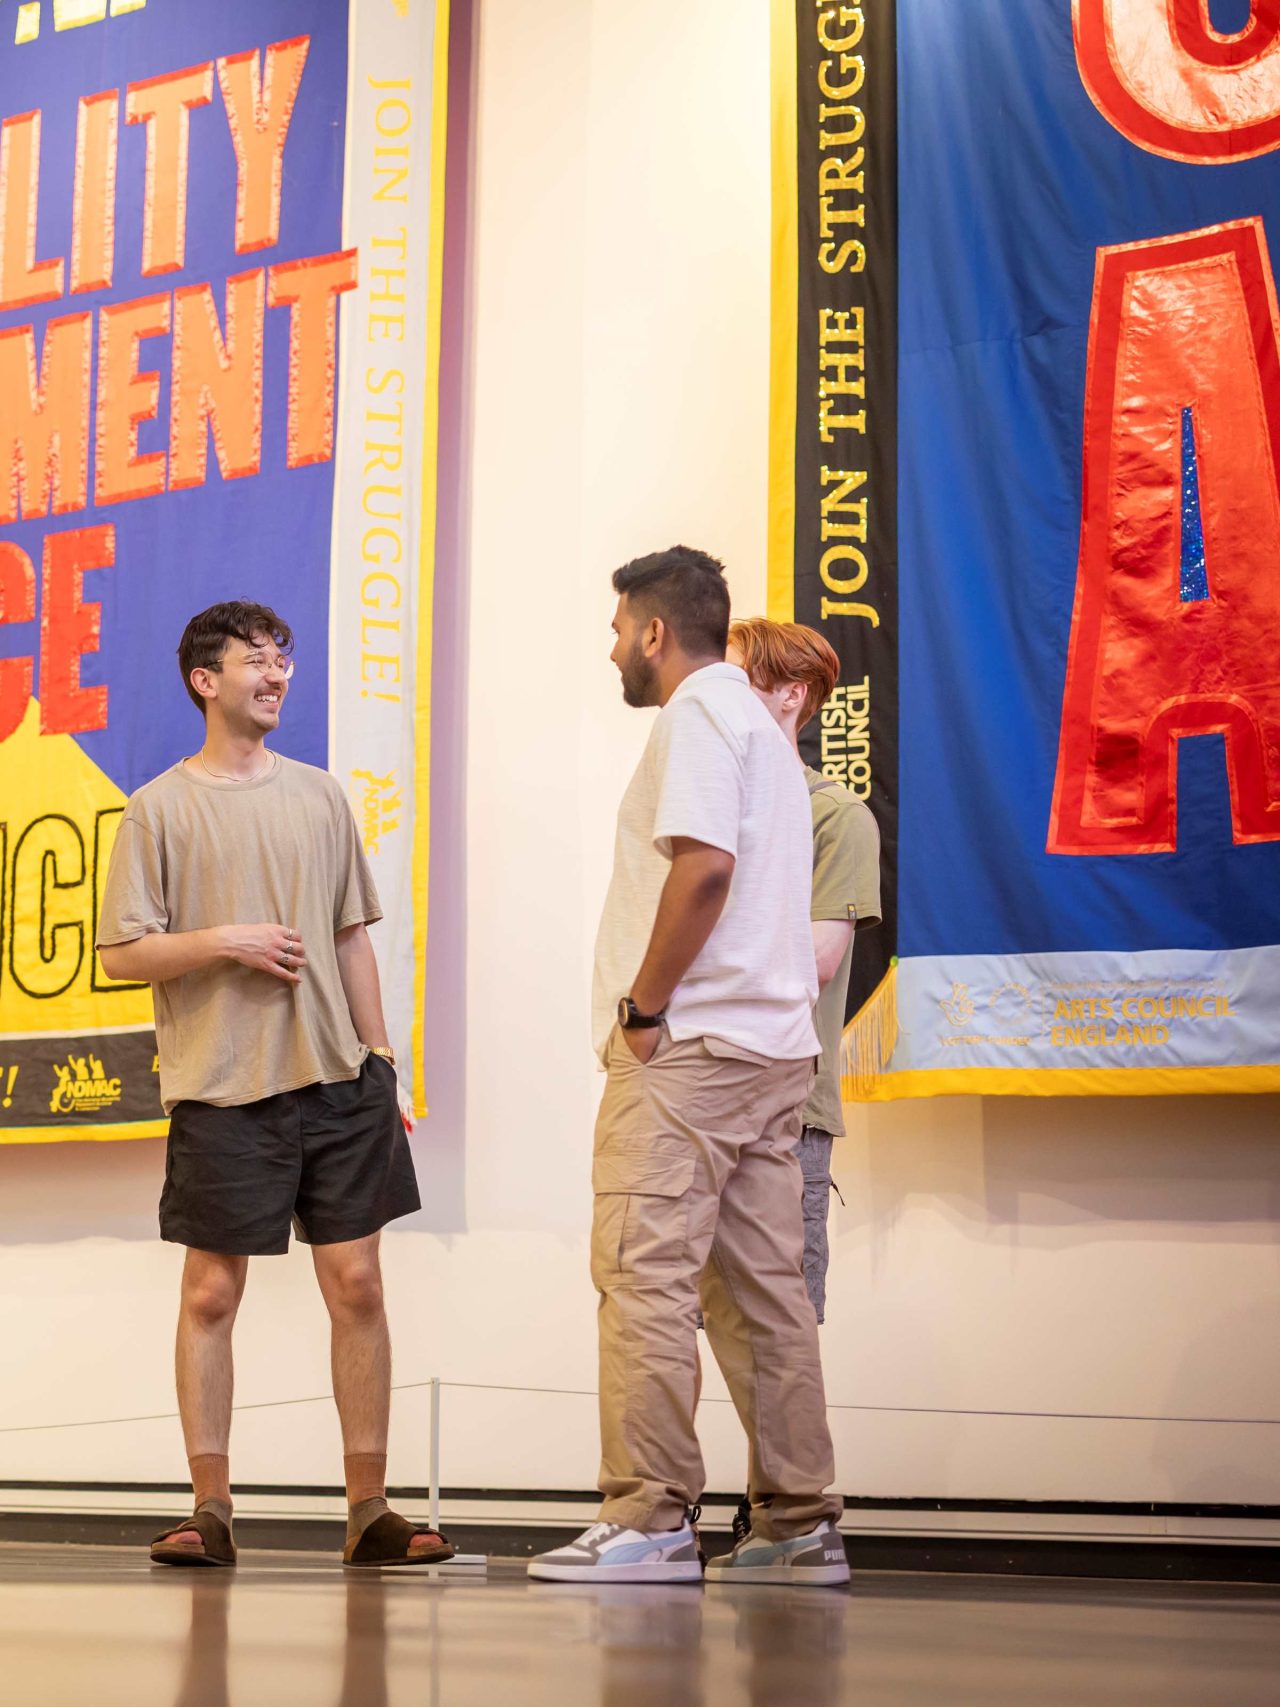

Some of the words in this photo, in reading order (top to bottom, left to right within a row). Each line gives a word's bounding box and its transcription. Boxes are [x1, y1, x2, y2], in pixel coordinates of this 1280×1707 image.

[368, 74, 411, 204] JOIN
[816, 0, 865, 273] STRUGG
[368, 226, 407, 342] THE
[819, 306, 866, 443] THE
[360, 368, 405, 703] STRUGGLE!
[820, 465, 880, 628] JOIN
[821, 686, 848, 789] RITISH
[846, 675, 872, 801] COUNCIL
[1050, 1023, 1170, 1047] ENGLAND
[1053, 997, 1114, 1020] ARTS
[1121, 995, 1237, 1019] COUNCIL
[824, 1549, 846, 1561] PUM
